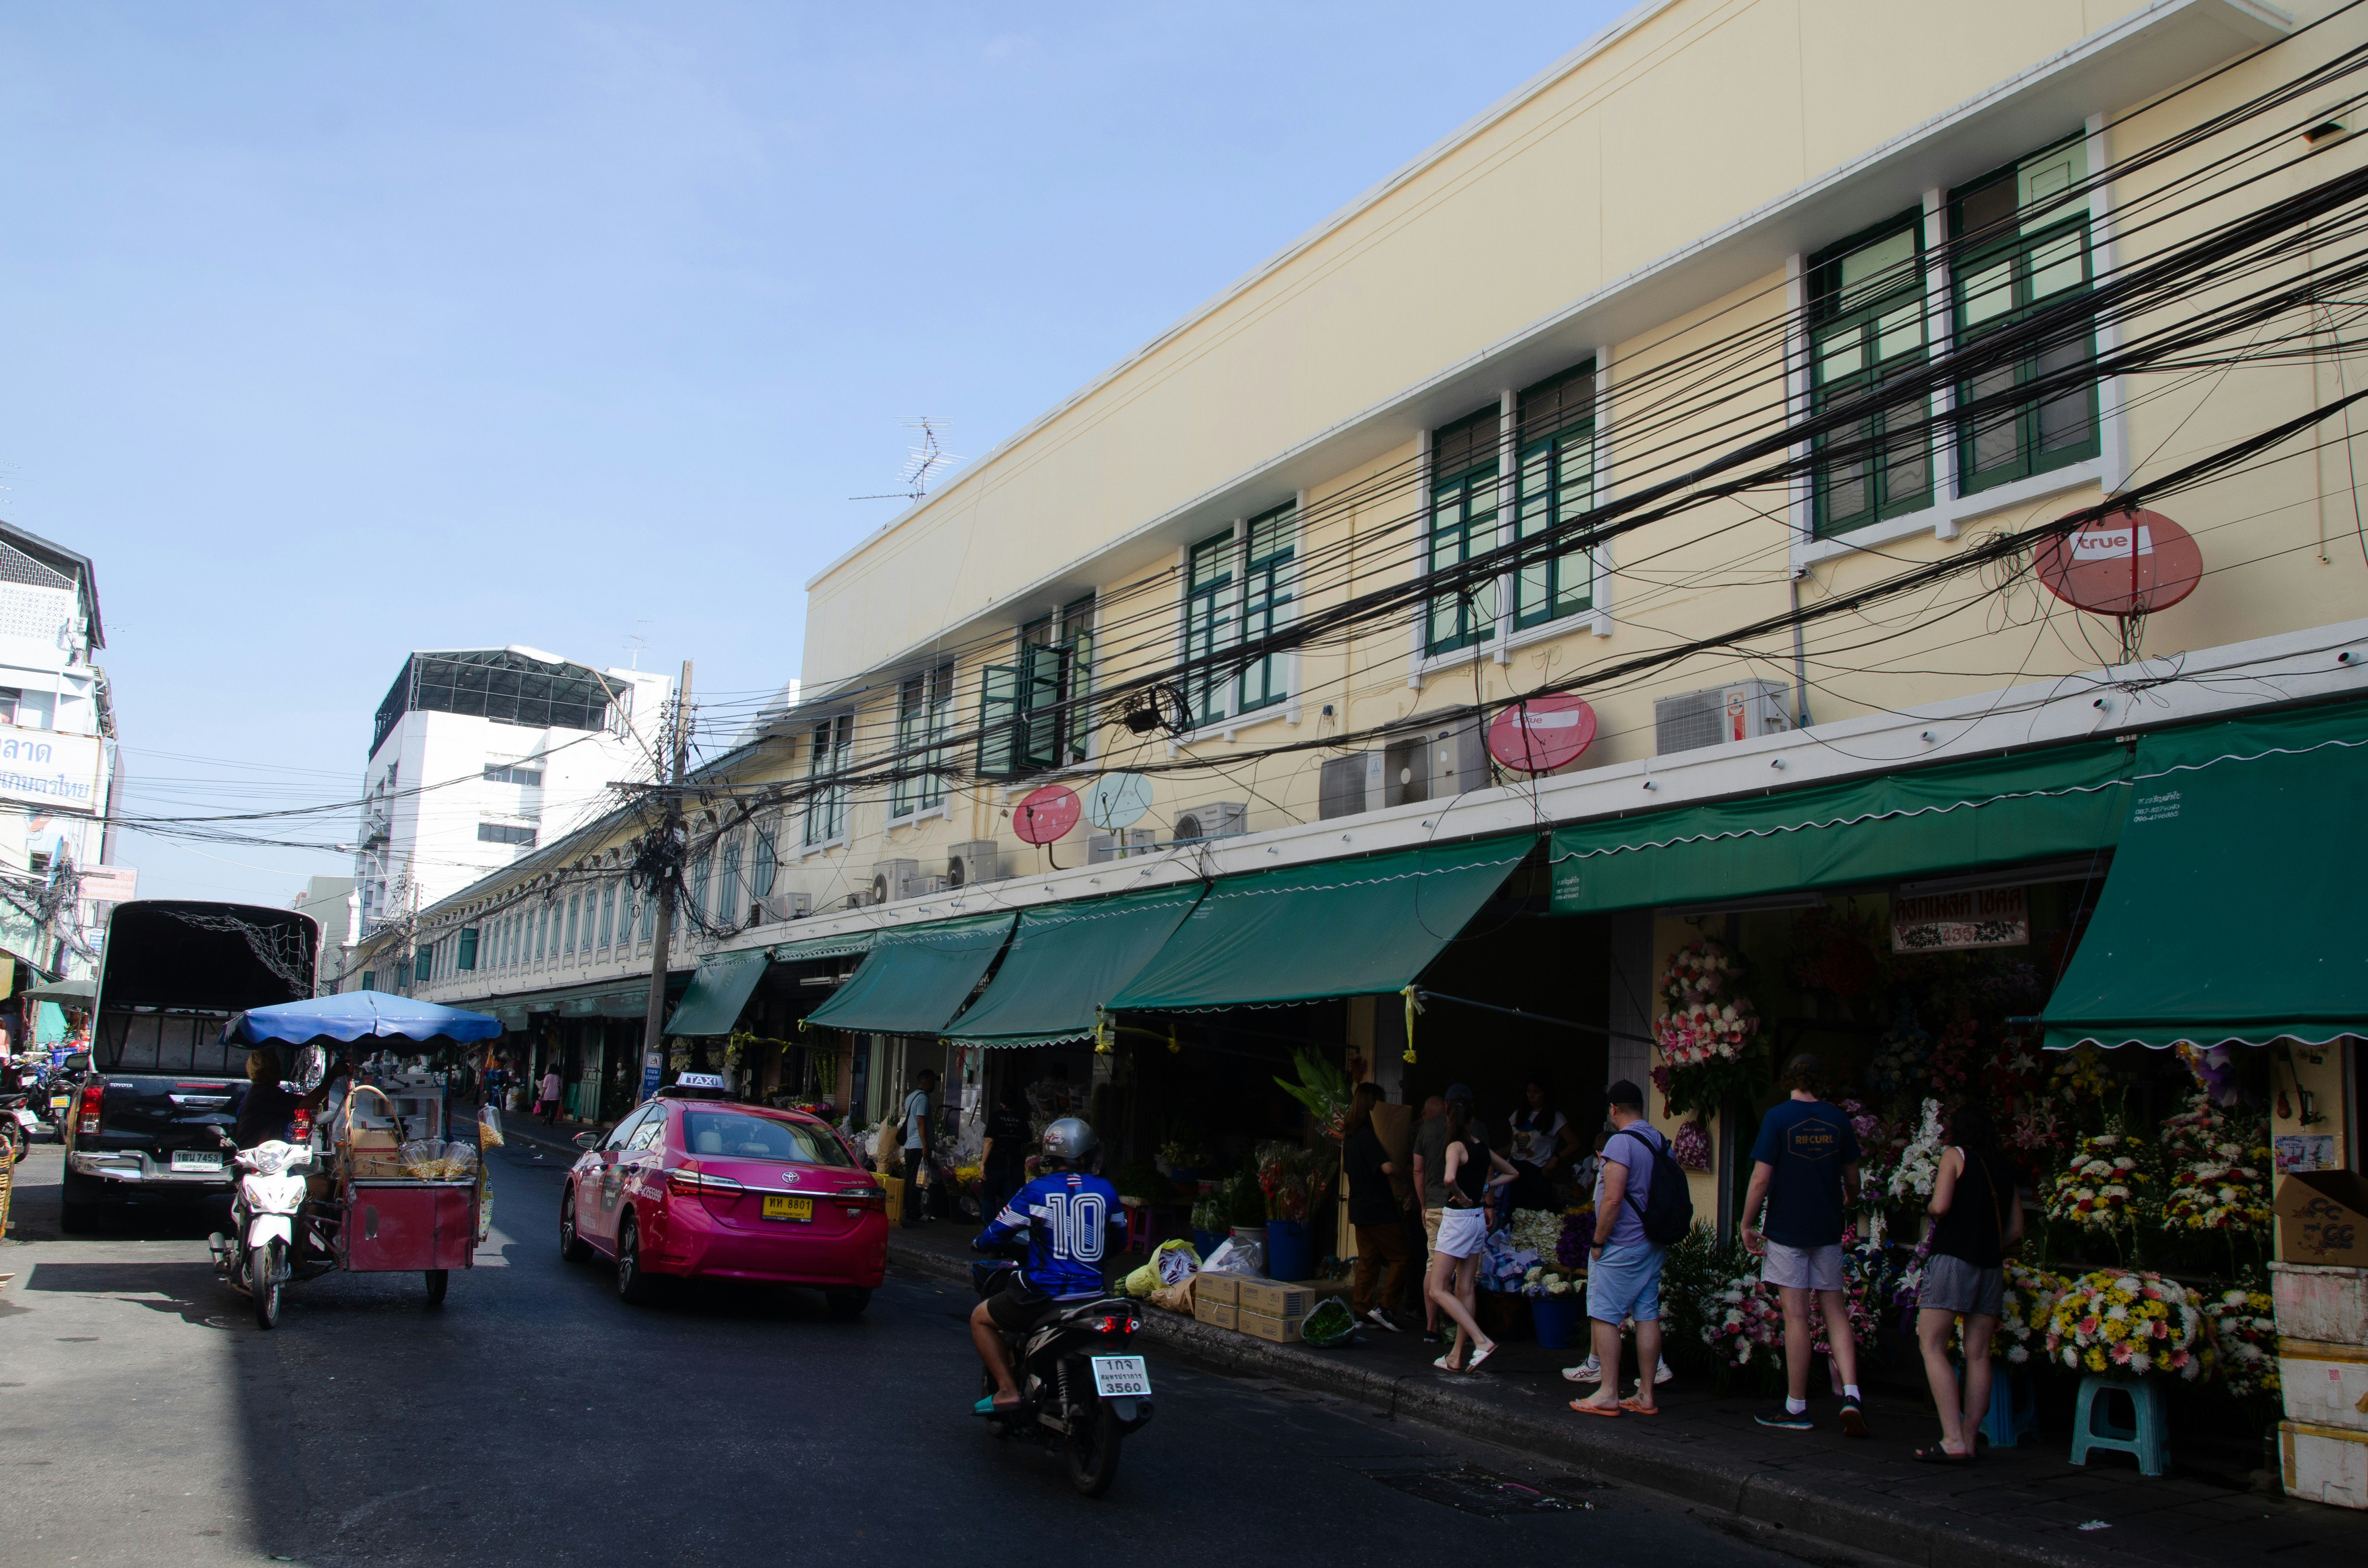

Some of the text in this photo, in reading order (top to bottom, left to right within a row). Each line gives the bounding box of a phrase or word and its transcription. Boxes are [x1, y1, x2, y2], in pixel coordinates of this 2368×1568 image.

[2077, 536, 2128, 549] true
[0, 739, 52, 763] ลาด
[0, 773, 90, 797] เกษตรไทย
[1942, 927, 1973, 942] 435
[688, 1076, 716, 1085] TAXI
[197, 1153, 218, 1162] 7453
[788, 1199, 810, 1210] 8801
[1045, 1192, 1106, 1262] 10
[1107, 1360, 1133, 1370] 1กจ
[1100, 1373, 1142, 1382] สมุทรปราการ
[1107, 1383, 1141, 1393] 3560
